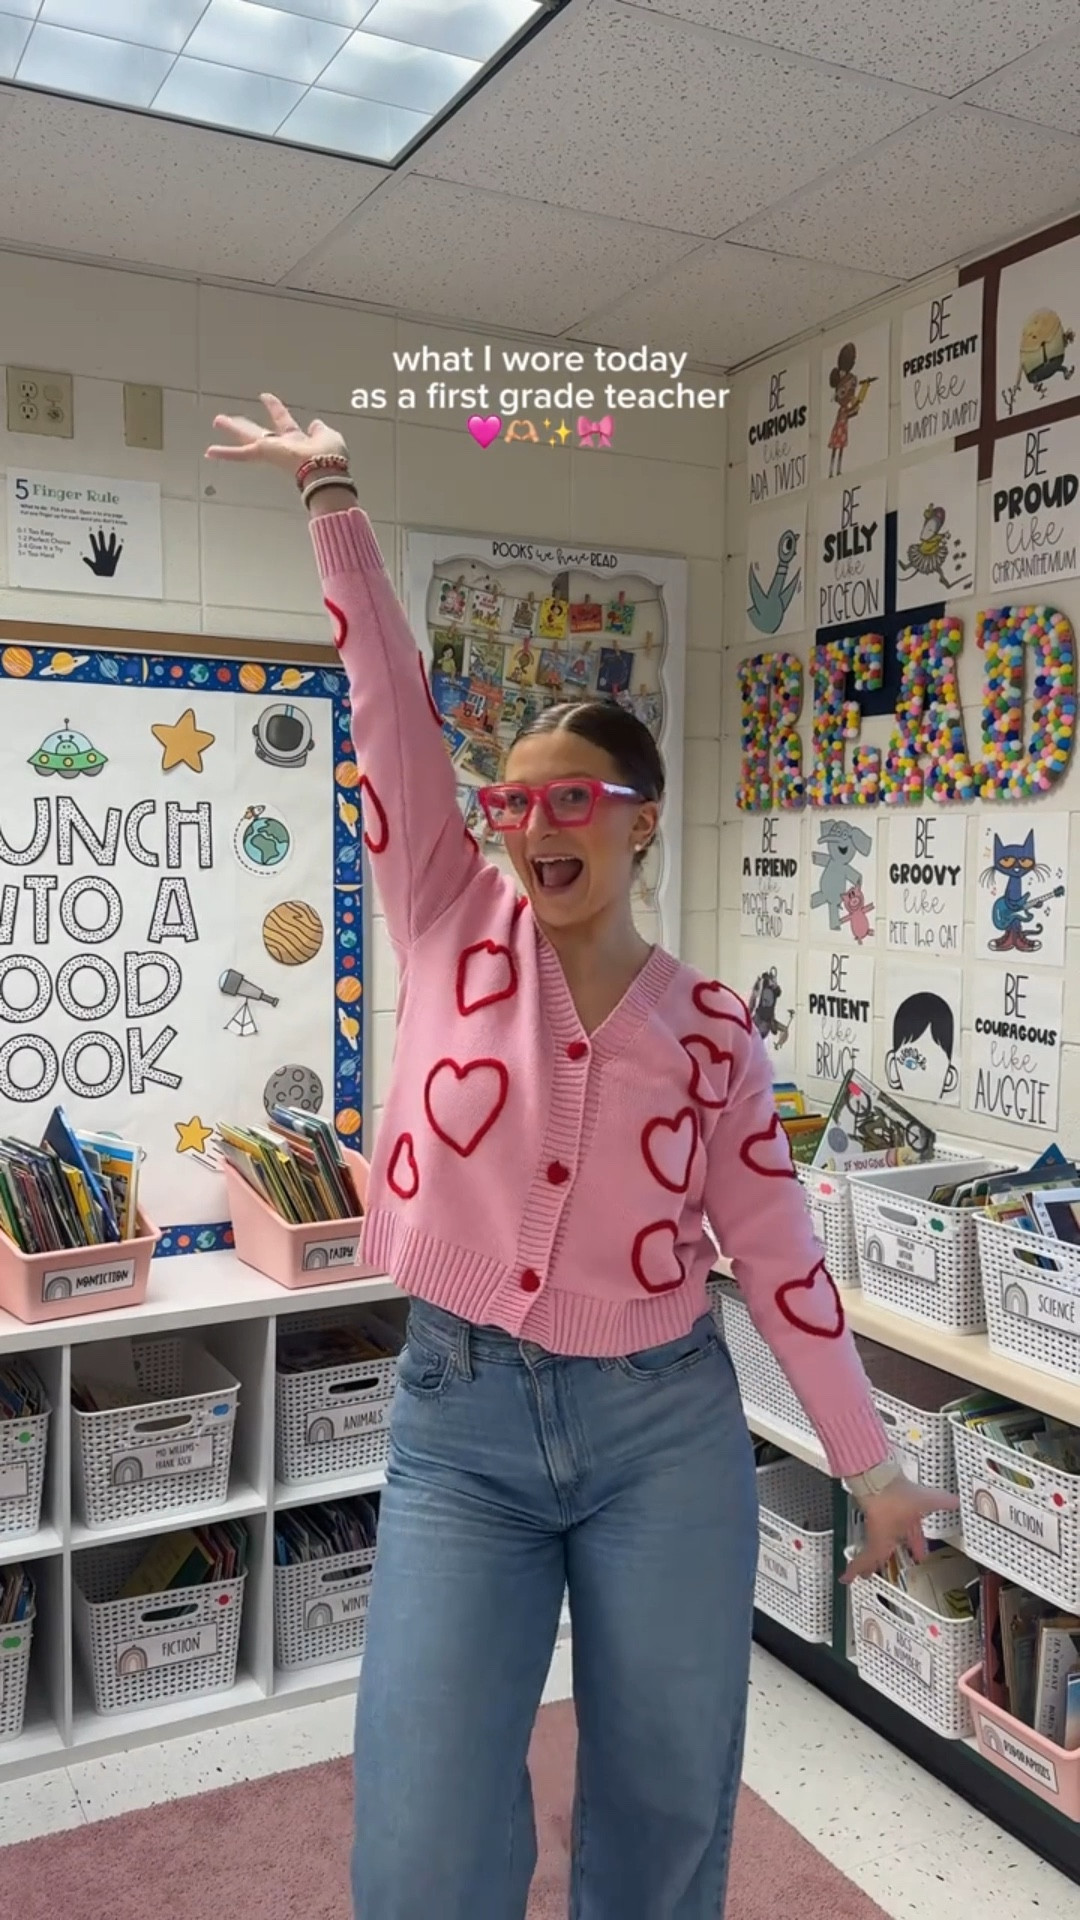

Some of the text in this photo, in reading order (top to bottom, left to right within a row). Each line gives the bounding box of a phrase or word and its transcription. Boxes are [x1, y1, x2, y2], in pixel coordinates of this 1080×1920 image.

[930, 294, 952, 344] BE
[903, 335, 978, 377] PERSISTENT
[769, 370, 787, 412] BE
[914, 372, 965, 411] like
[749, 405, 807, 445] CURIOUS
[903, 399, 978, 445] HUMPTY DUMPTY
[1023, 428, 1051, 479] BE
[15, 478, 120, 505] 5 Finger Rule
[749, 454, 806, 504] ADA TWIST
[993, 474, 1079, 522] PROUD
[841, 486, 861, 529] BE
[492, 541, 533, 560] BOOKS
[590, 552, 618, 569] READ
[823, 521, 878, 563] SILLY
[1006, 518, 1064, 555] like
[992, 548, 1076, 583] CHRYSANTHEMUM
[819, 578, 879, 626] PIGEON
[736, 605, 1077, 810] READ
[762, 817, 779, 853] BE
[915, 817, 936, 858] BE
[742, 857, 798, 877] A FRIEND
[889, 863, 961, 886] GROOVY
[147, 877, 199, 943] A
[903, 888, 945, 916] like
[889, 921, 908, 945] PETE
[939, 925, 958, 949] CAT
[830, 953, 849, 993] BE
[809, 993, 870, 1023] PATIENT
[1005, 973, 1028, 1019] BE
[821, 1019, 857, 1044] like
[975, 1017, 1057, 1046] COURAGOUS
[0, 1025, 182, 1103] OOK
[990, 1040, 1038, 1074] like
[974, 1068, 1050, 1125] AUGGIE
[853, 1159, 868, 1171] YOU
[76, 1269, 129, 1289] NONFICTION
[1038, 1293, 1075, 1323] SCIENCE
[343, 1410, 383, 1431] ANIMALS
[1009, 1505, 1043, 1537] FICTION
[162, 1637, 200, 1657] FICTION
